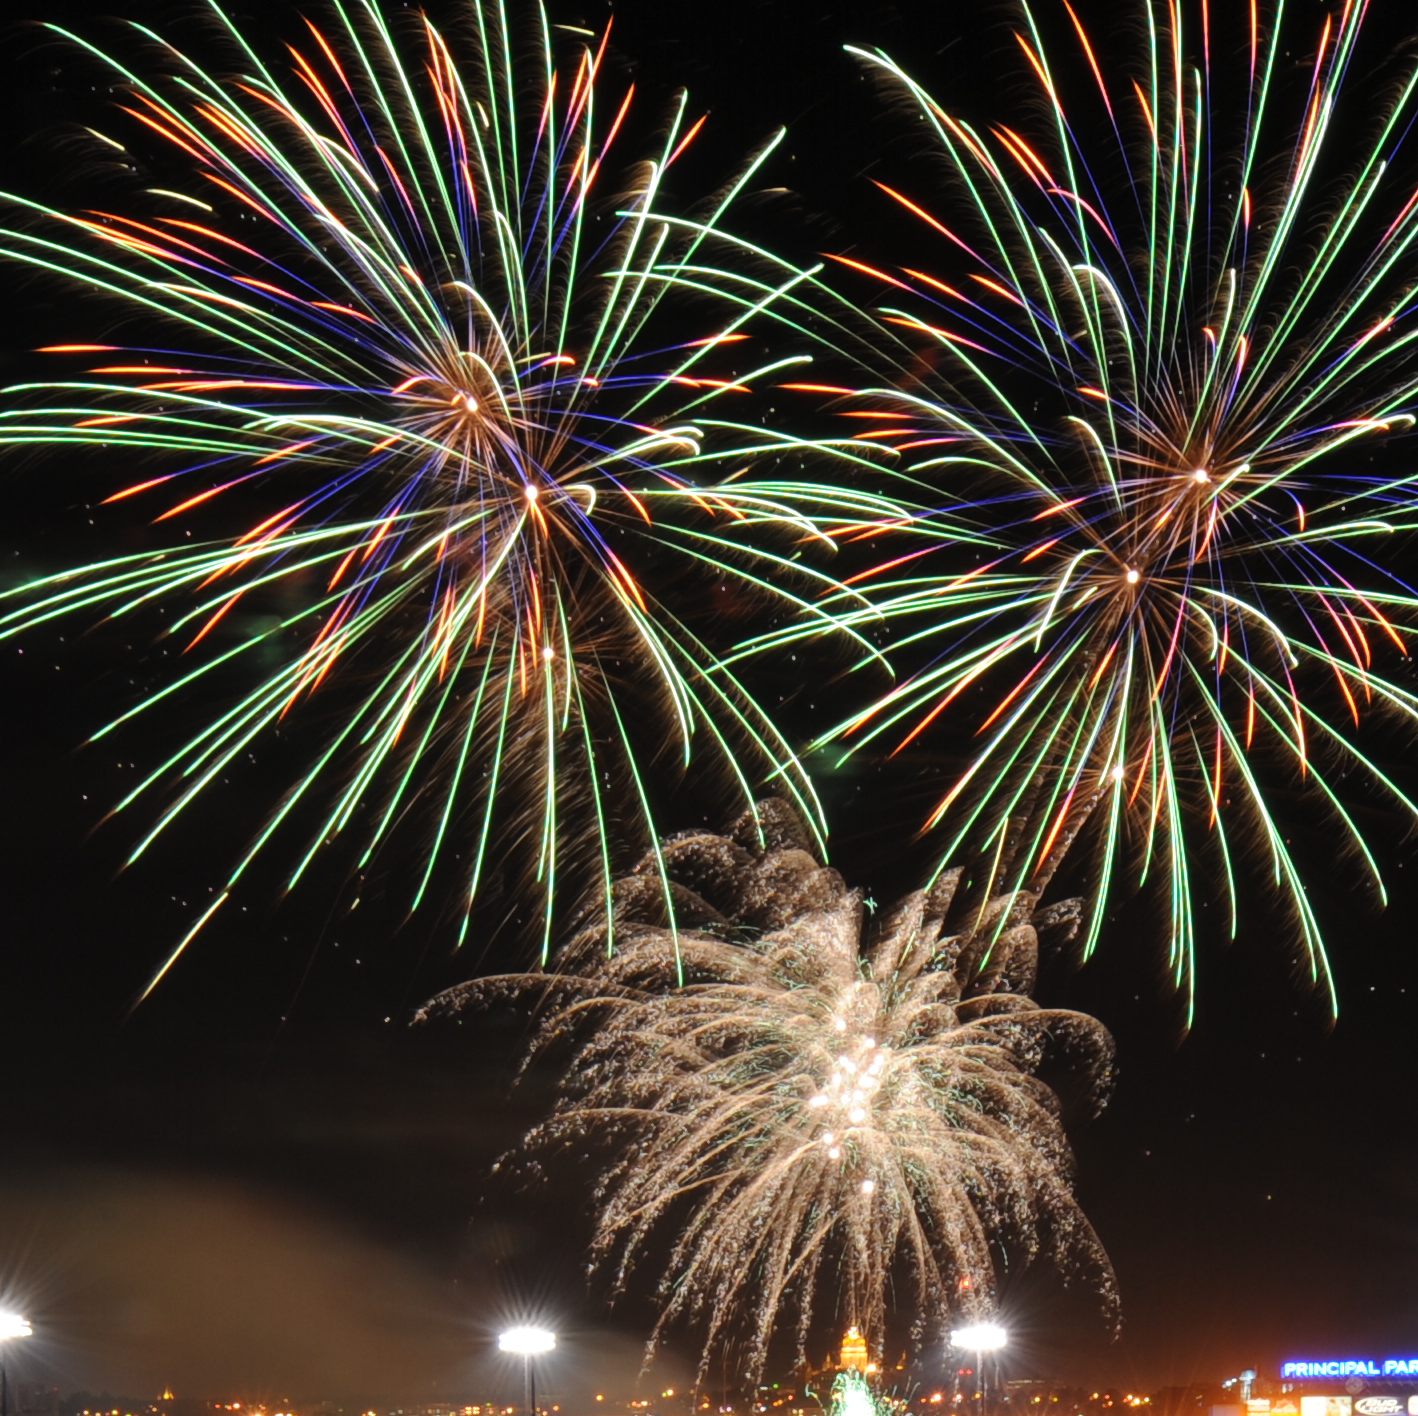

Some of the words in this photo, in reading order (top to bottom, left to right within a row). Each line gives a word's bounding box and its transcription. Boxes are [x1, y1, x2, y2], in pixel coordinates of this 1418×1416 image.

[1284, 1361, 1380, 1376] PRINCIPAL
[1365, 1398, 1398, 1406] BUD
[1362, 1405, 1403, 1413] LIGHT
